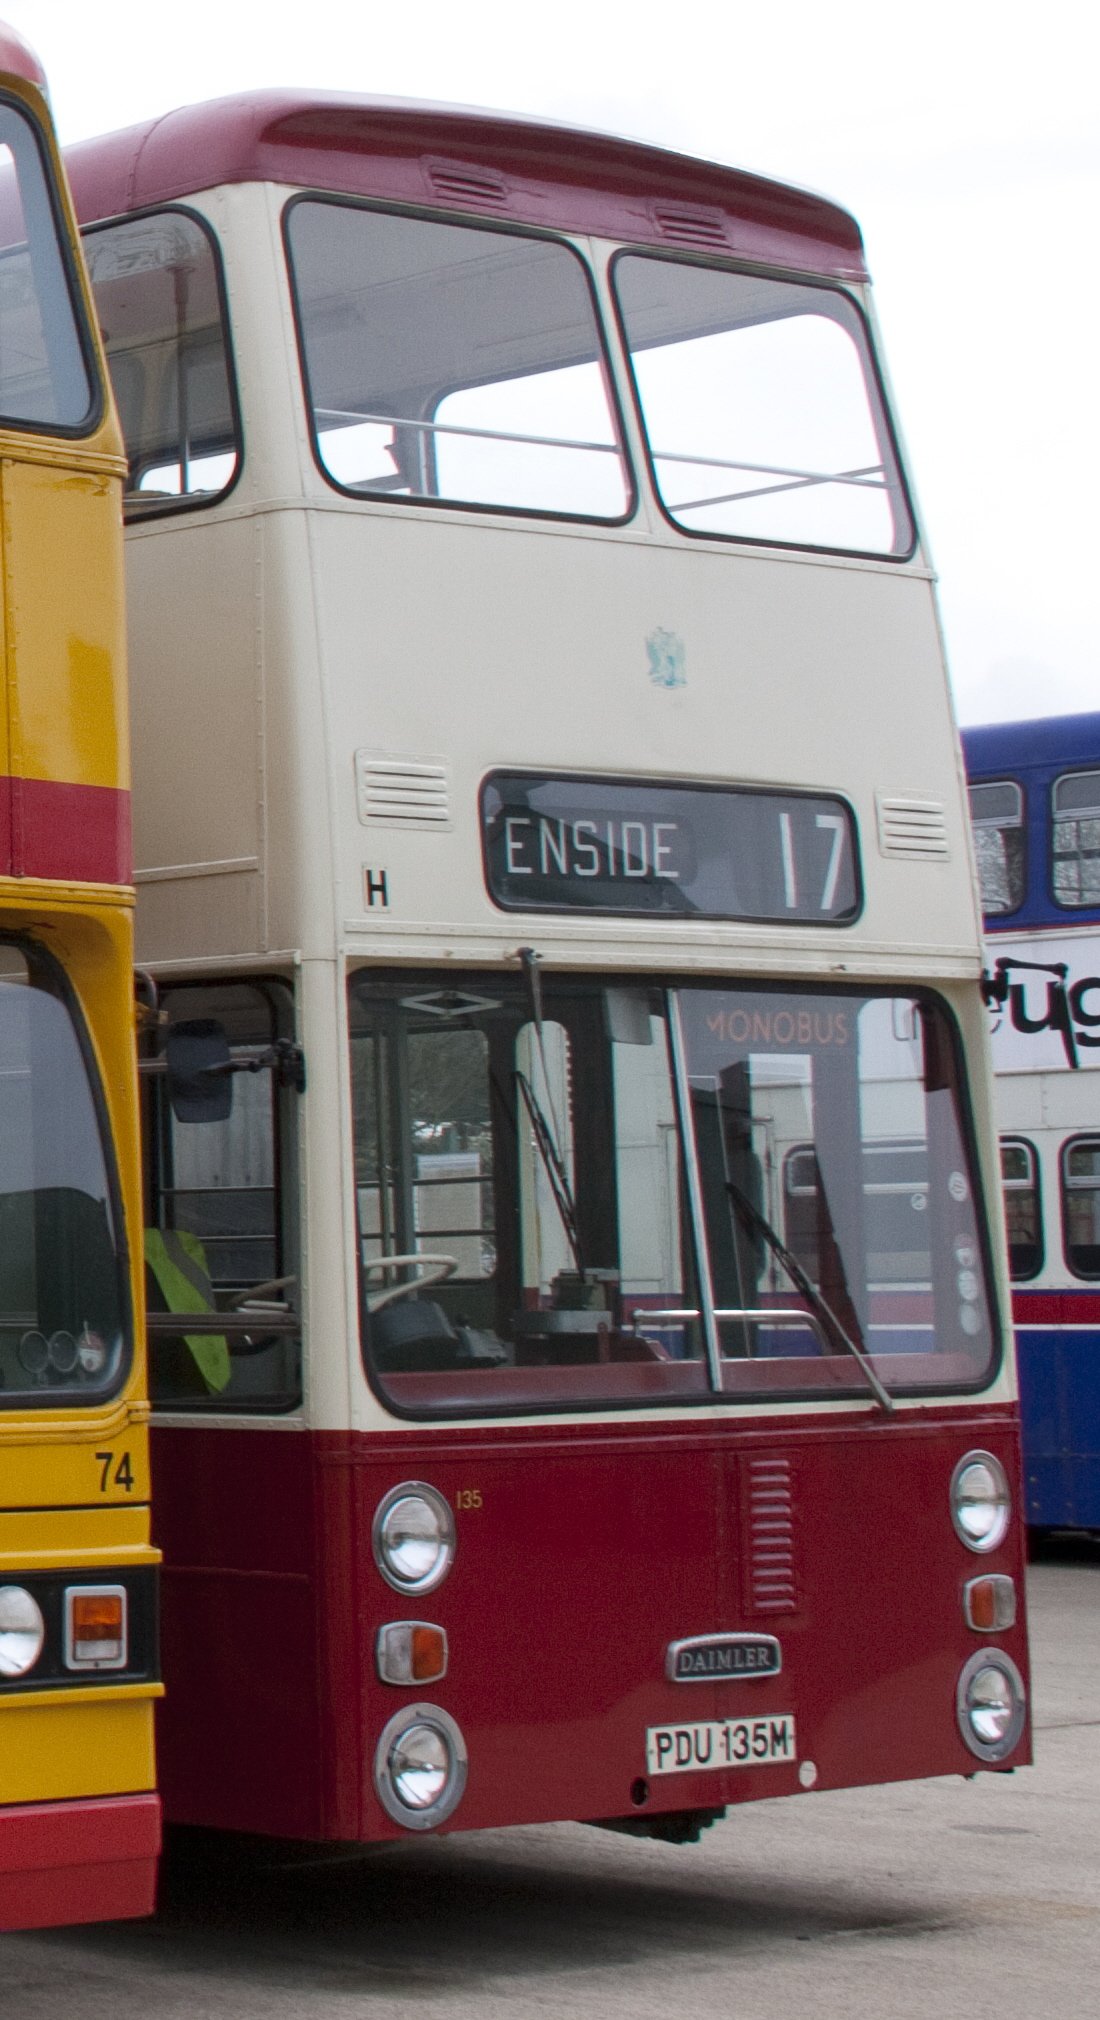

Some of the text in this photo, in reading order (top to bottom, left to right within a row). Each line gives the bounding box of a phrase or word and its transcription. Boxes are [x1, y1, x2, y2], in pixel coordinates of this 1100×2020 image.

[484, 815, 680, 878] ENSIDE
[780, 812, 845, 910] 17
[366, 869, 388, 906] H
[706, 1008, 850, 1044] MONOBUS
[95, 1451, 134, 1492] 74
[456, 1490, 482, 1509] 135
[679, 1647, 771, 1673] DAIMLER
[655, 1720, 788, 1769] PDU 135M
